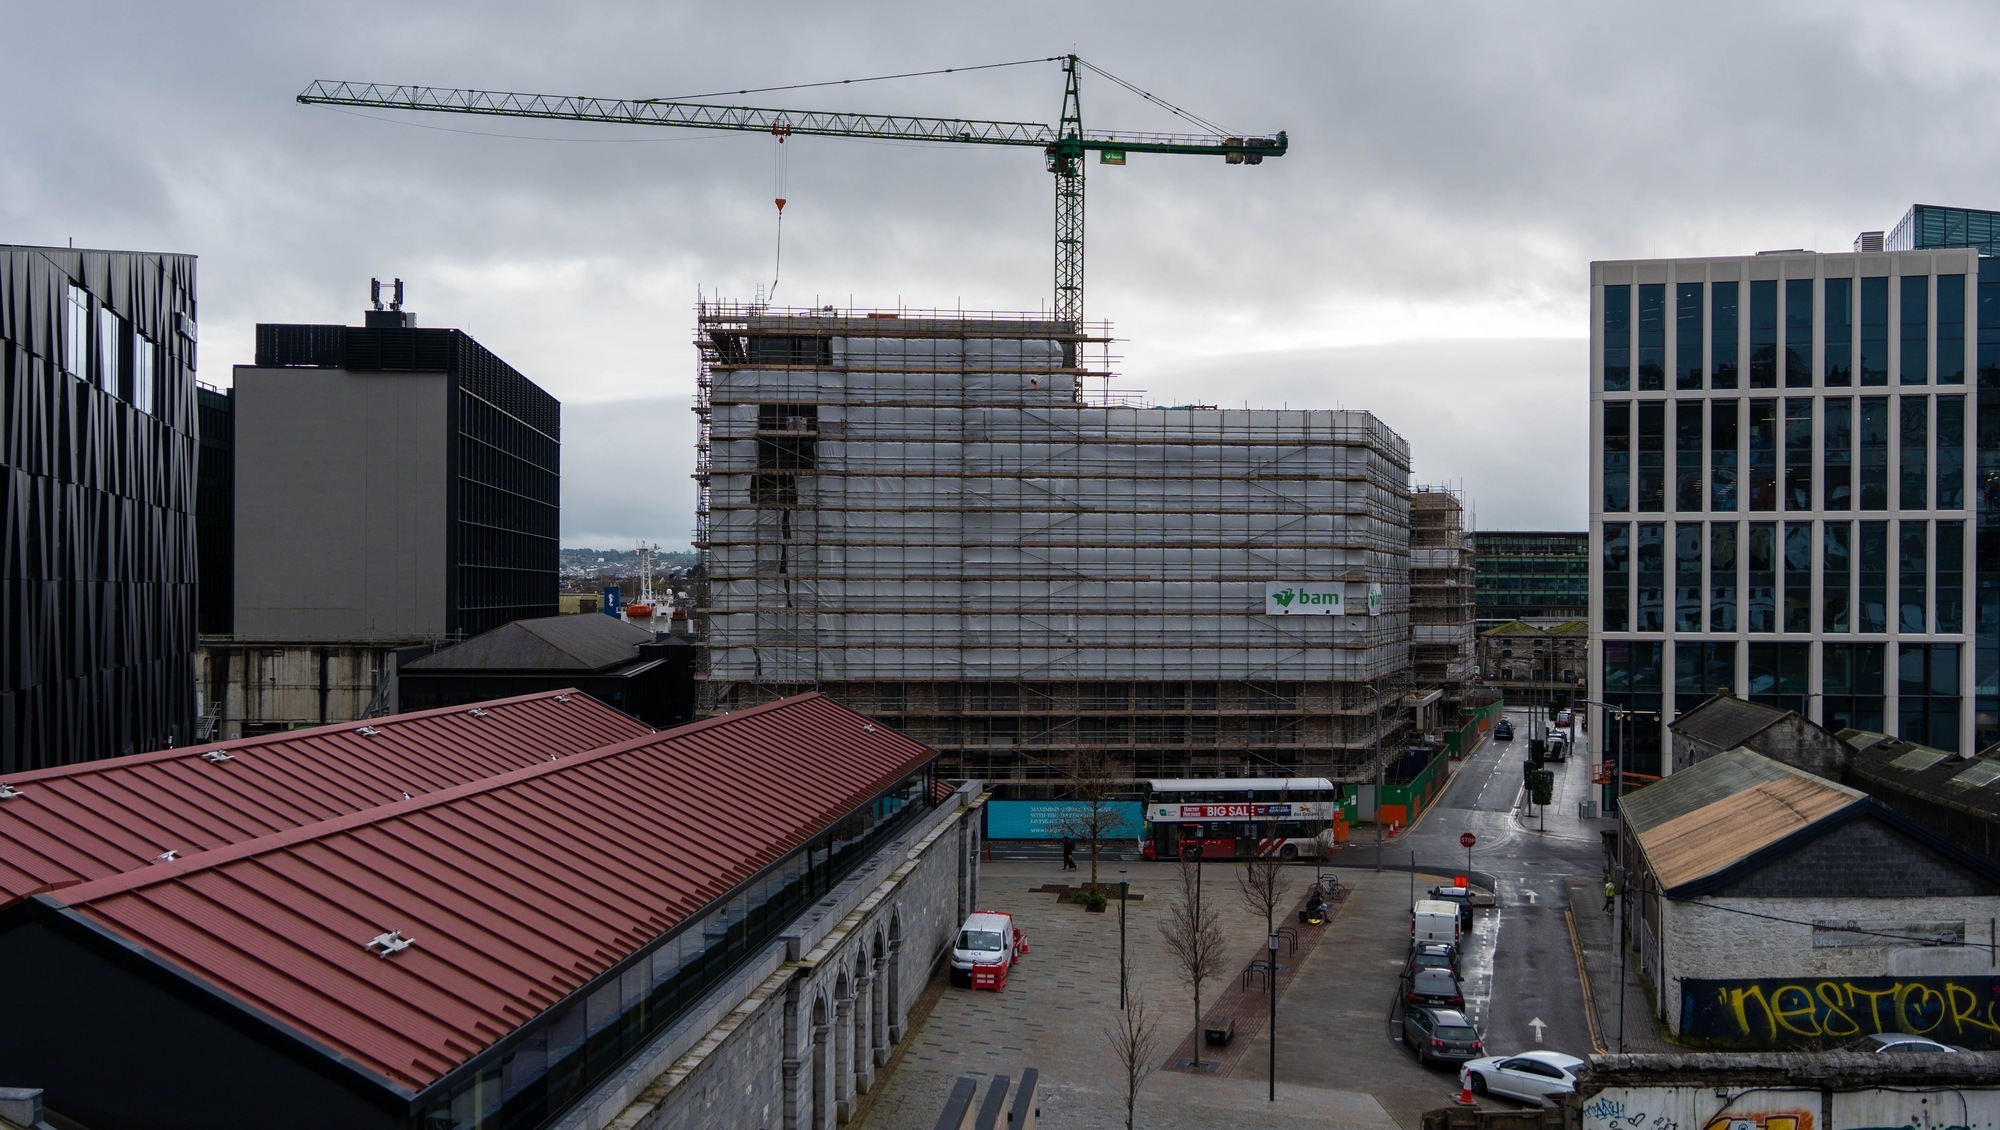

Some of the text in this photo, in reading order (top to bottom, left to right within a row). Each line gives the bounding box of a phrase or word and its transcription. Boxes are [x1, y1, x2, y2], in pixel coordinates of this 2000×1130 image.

[1299, 588, 1339, 604] bam
[1207, 806, 1254, 817] BIG SALE
[1815, 936, 1842, 948] Jeep
